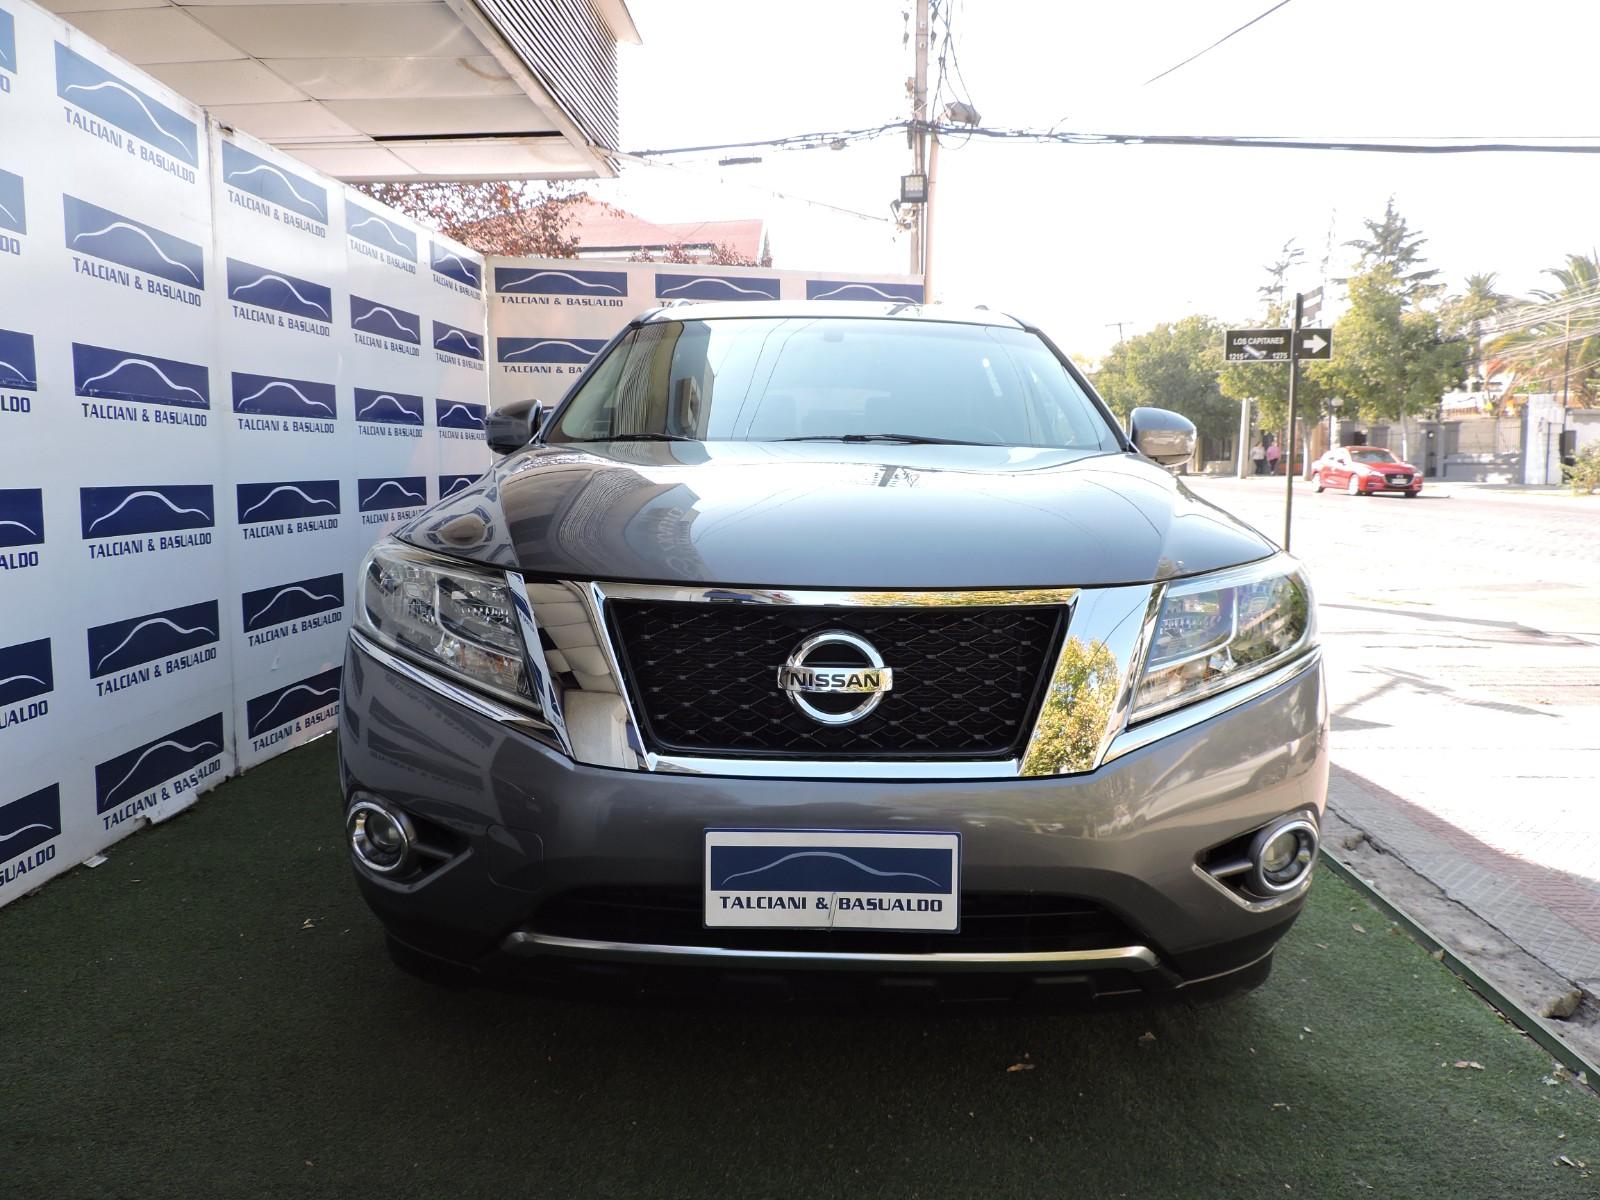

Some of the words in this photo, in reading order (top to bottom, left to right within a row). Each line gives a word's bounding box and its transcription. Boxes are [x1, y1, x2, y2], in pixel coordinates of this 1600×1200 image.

[64, 106, 122, 148] TALCIANI
[126, 139, 136, 155] &
[140, 145, 196, 184] BASUALDO
[228, 189, 270, 217] TALCIANI
[274, 208, 280, 220] &
[284, 212, 326, 238] BASUALDO
[350, 239, 378, 260] TALCIANI
[387, 255, 416, 275] BASUALDO
[73, 257, 130, 287] TALCIANI
[134, 276, 143, 290] &
[148, 280, 202, 307] BASUALDO
[500, 296, 550, 304] TALCIANI
[554, 297, 562, 305] &
[566, 298, 624, 307] BASUALDO
[233, 305, 274, 326] TALCIANI
[278, 316, 284, 328] &
[288, 318, 330, 337] BASUALDO
[354, 333, 382, 348] TALCIANI
[390, 342, 420, 356] BASUALDO
[1233, 338, 1247, 346] LOS
[1248, 336, 1284, 344] CAPITANES
[503, 365, 552, 374] TALCIANI
[556, 366, 564, 374] &
[82, 402, 137, 422] TALCIANI
[142, 408, 150, 422] &
[154, 410, 207, 426] BASUALDO
[238, 418, 280, 432] TALCIANI
[283, 420, 289, 432] &
[292, 422, 334, 434] BASUALDO
[359, 425, 386, 436] TALCIANI
[394, 428, 423, 438] BASUALDO
[243, 524, 284, 540] TALCIANI
[288, 523, 294, 534] &
[297, 518, 338, 533] BASUALDO
[88, 540, 142, 559] TALCIANI
[148, 538, 156, 552] &
[160, 532, 212, 550] BASUALDO
[248, 625, 288, 648] TALCIANI
[292, 624, 298, 634] &
[302, 611, 342, 632] BASUALDO
[96, 668, 150, 696] TALCIANI
[154, 664, 162, 678] &
[166, 648, 216, 674] BASUALDO
[790, 672, 880, 688] NISSAN
[253, 725, 292, 752] TALCIANI
[296, 721, 302, 732] &
[103, 792, 157, 830] TALCIANI
[162, 788, 170, 800] &
[174, 759, 220, 794] BASALDO
[720, 896, 807, 910] TALCIANI
[816, 896, 829, 910] &
[838, 898, 943, 912] BASUALDO
